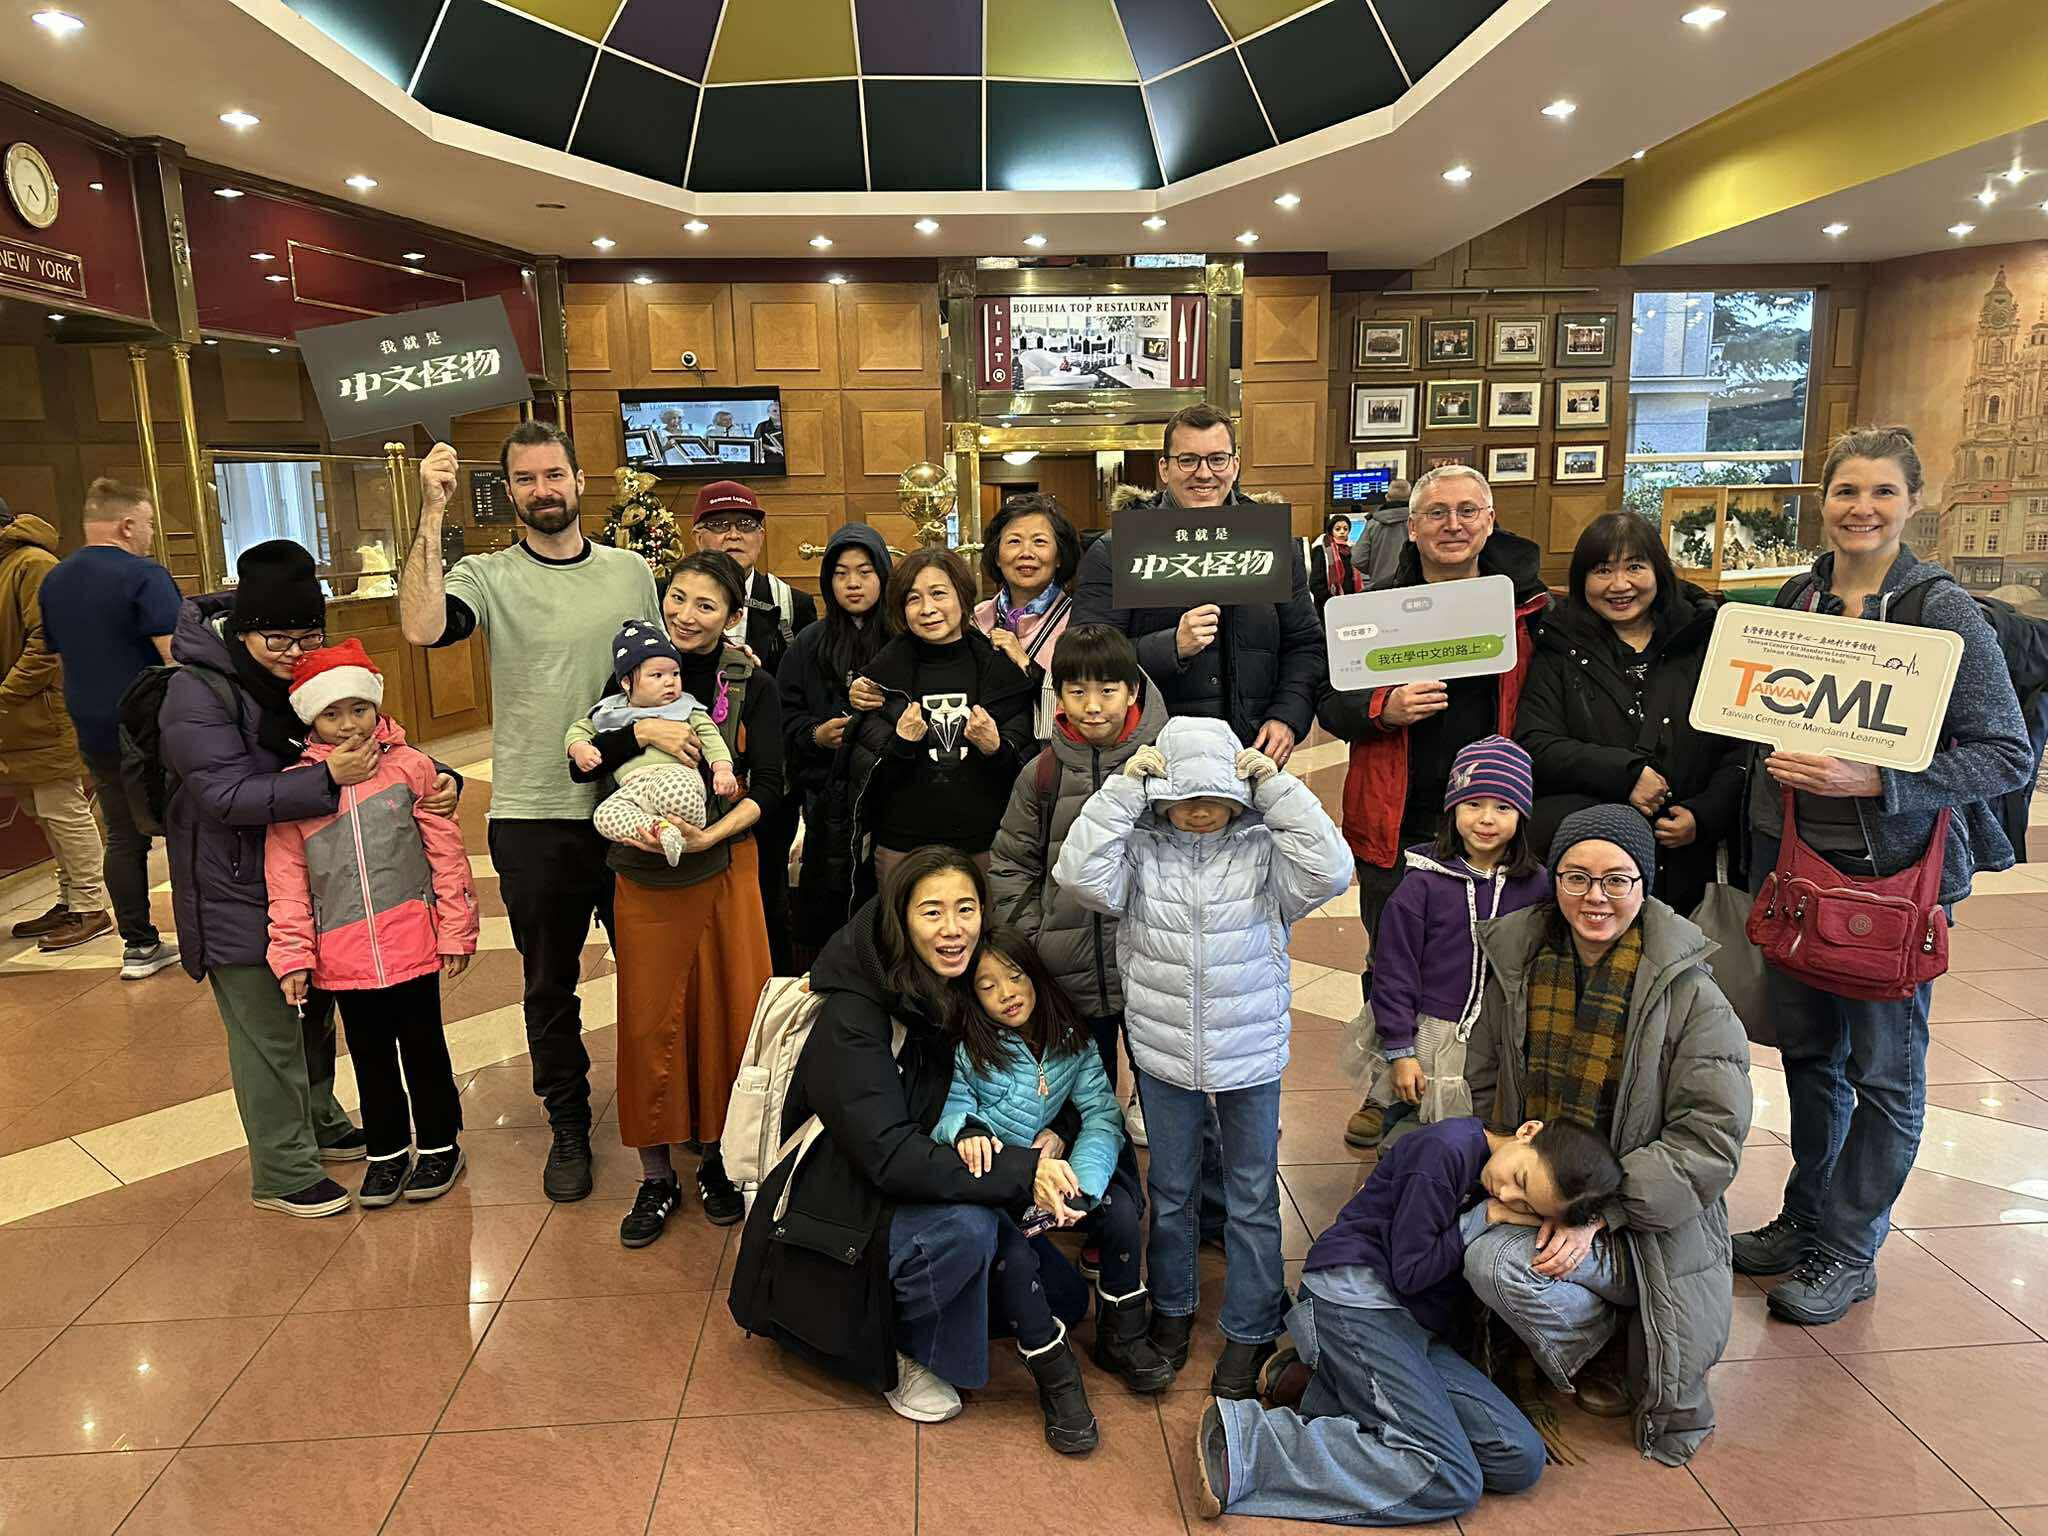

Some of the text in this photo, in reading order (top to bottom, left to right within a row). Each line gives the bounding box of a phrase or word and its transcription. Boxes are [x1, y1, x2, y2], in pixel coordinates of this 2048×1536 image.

[0, 250, 75, 284] NEW YORK
[1013, 302, 1169, 313] BOHEMIA TOP RESTAURANT
[379, 330, 442, 355] 我就是
[994, 305, 1004, 363] LIFT
[338, 348, 500, 402] 中文怪物
[1175, 527, 1229, 543] 我就是
[1130, 549, 1275, 580] 中文怪物
[1378, 642, 1481, 666] 我在學中文的路上
[1729, 659, 1908, 737] TCML
[1721, 707, 1896, 748] Taiwan Center for Mandarin Learning
